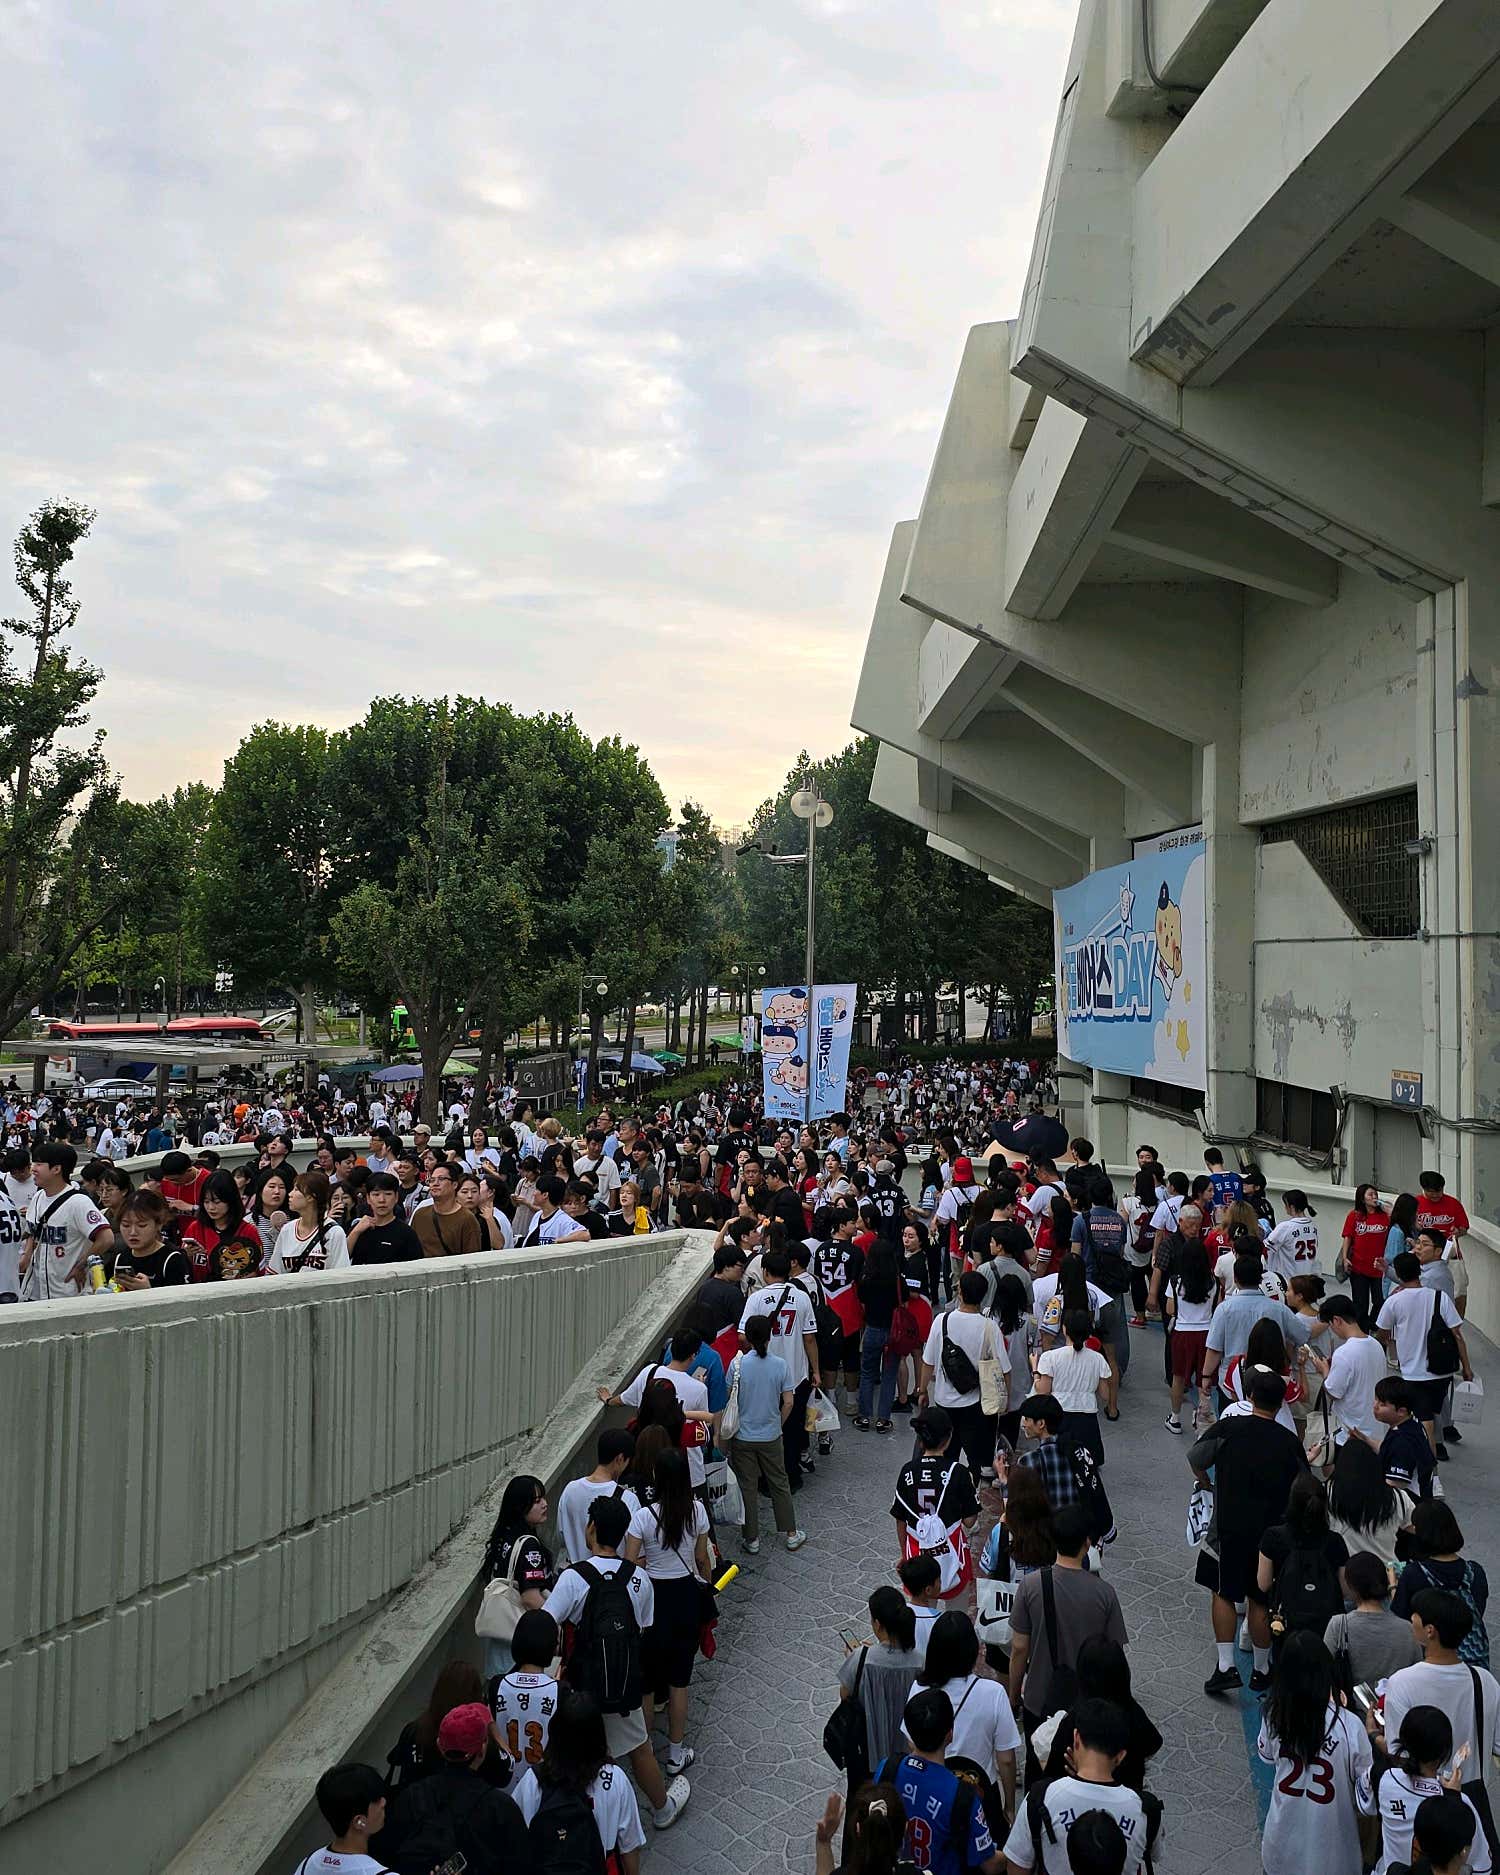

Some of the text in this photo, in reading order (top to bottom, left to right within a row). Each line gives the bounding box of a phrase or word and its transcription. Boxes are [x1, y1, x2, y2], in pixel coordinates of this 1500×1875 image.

[0, 1209, 21, 1244] 53
[1295, 1239, 1317, 1261] 25
[821, 1261, 847, 1285] 54
[496, 1692, 556, 1717] 윤영철
[506, 1718, 544, 1765] 13
[1278, 1749, 1336, 1805] 23
[1060, 1808, 1137, 1841] 김빈
